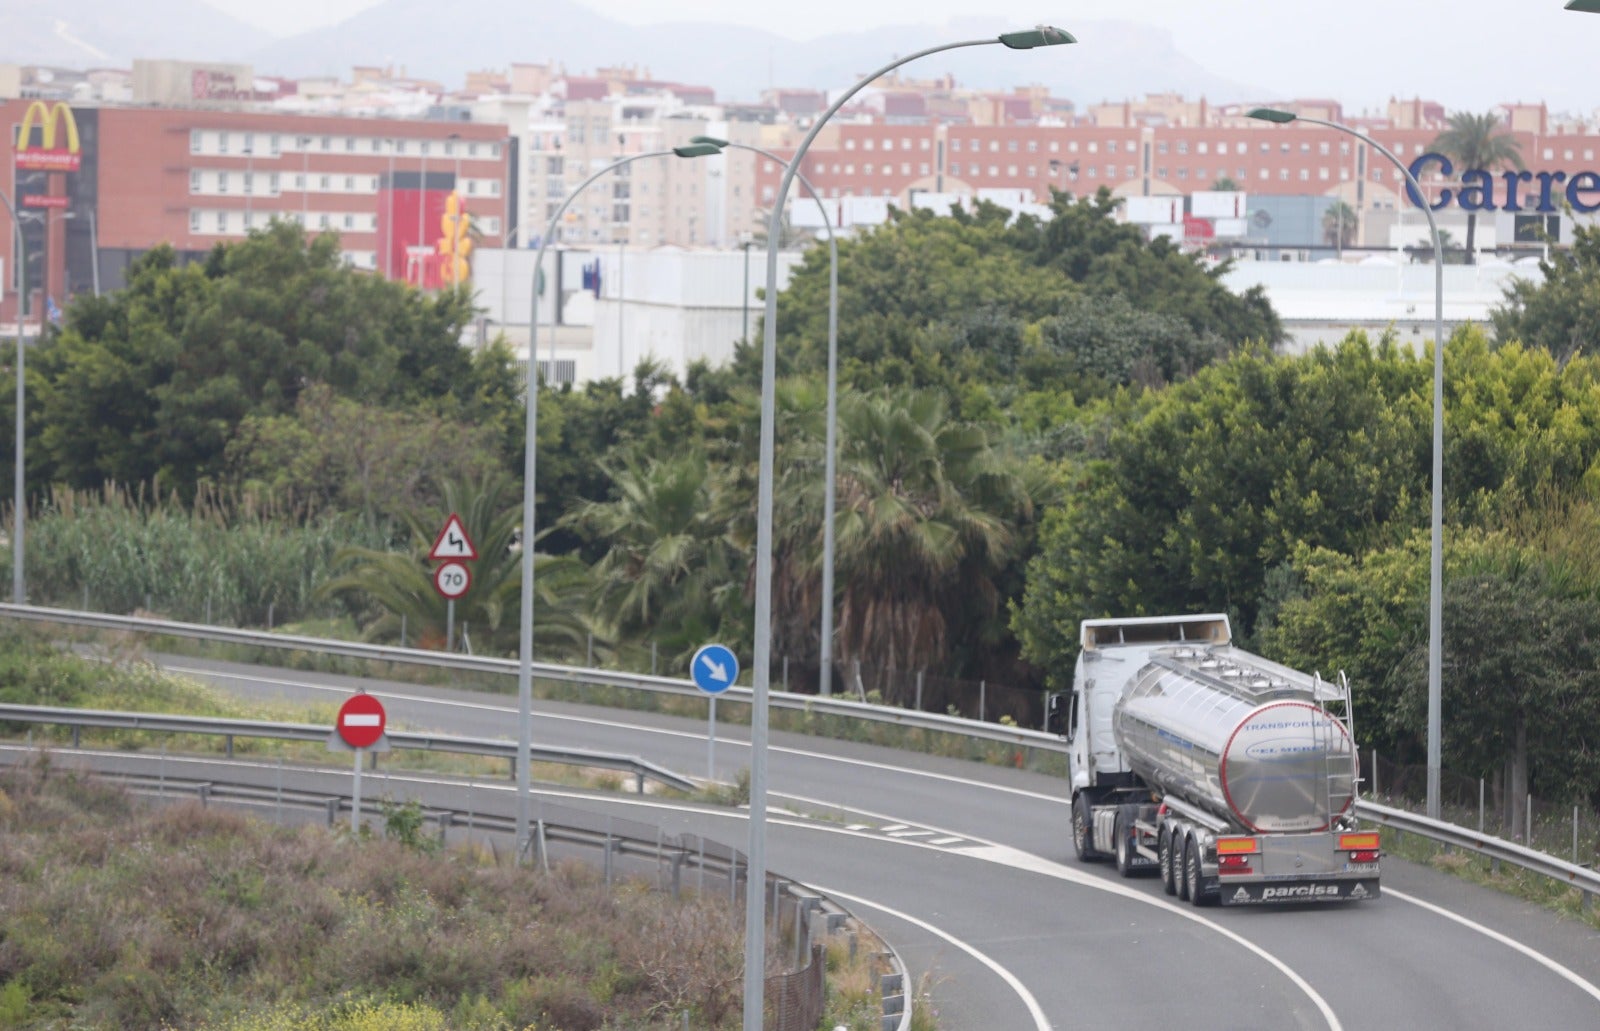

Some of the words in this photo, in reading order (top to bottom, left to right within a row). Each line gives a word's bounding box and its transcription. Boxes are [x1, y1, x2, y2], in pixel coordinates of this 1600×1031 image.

[1405, 153, 1600, 213] Carre
[443, 573, 463, 586] 70
[1245, 720, 1331, 731] TRANSPORTES
[1262, 883, 1339, 899] parcisa
